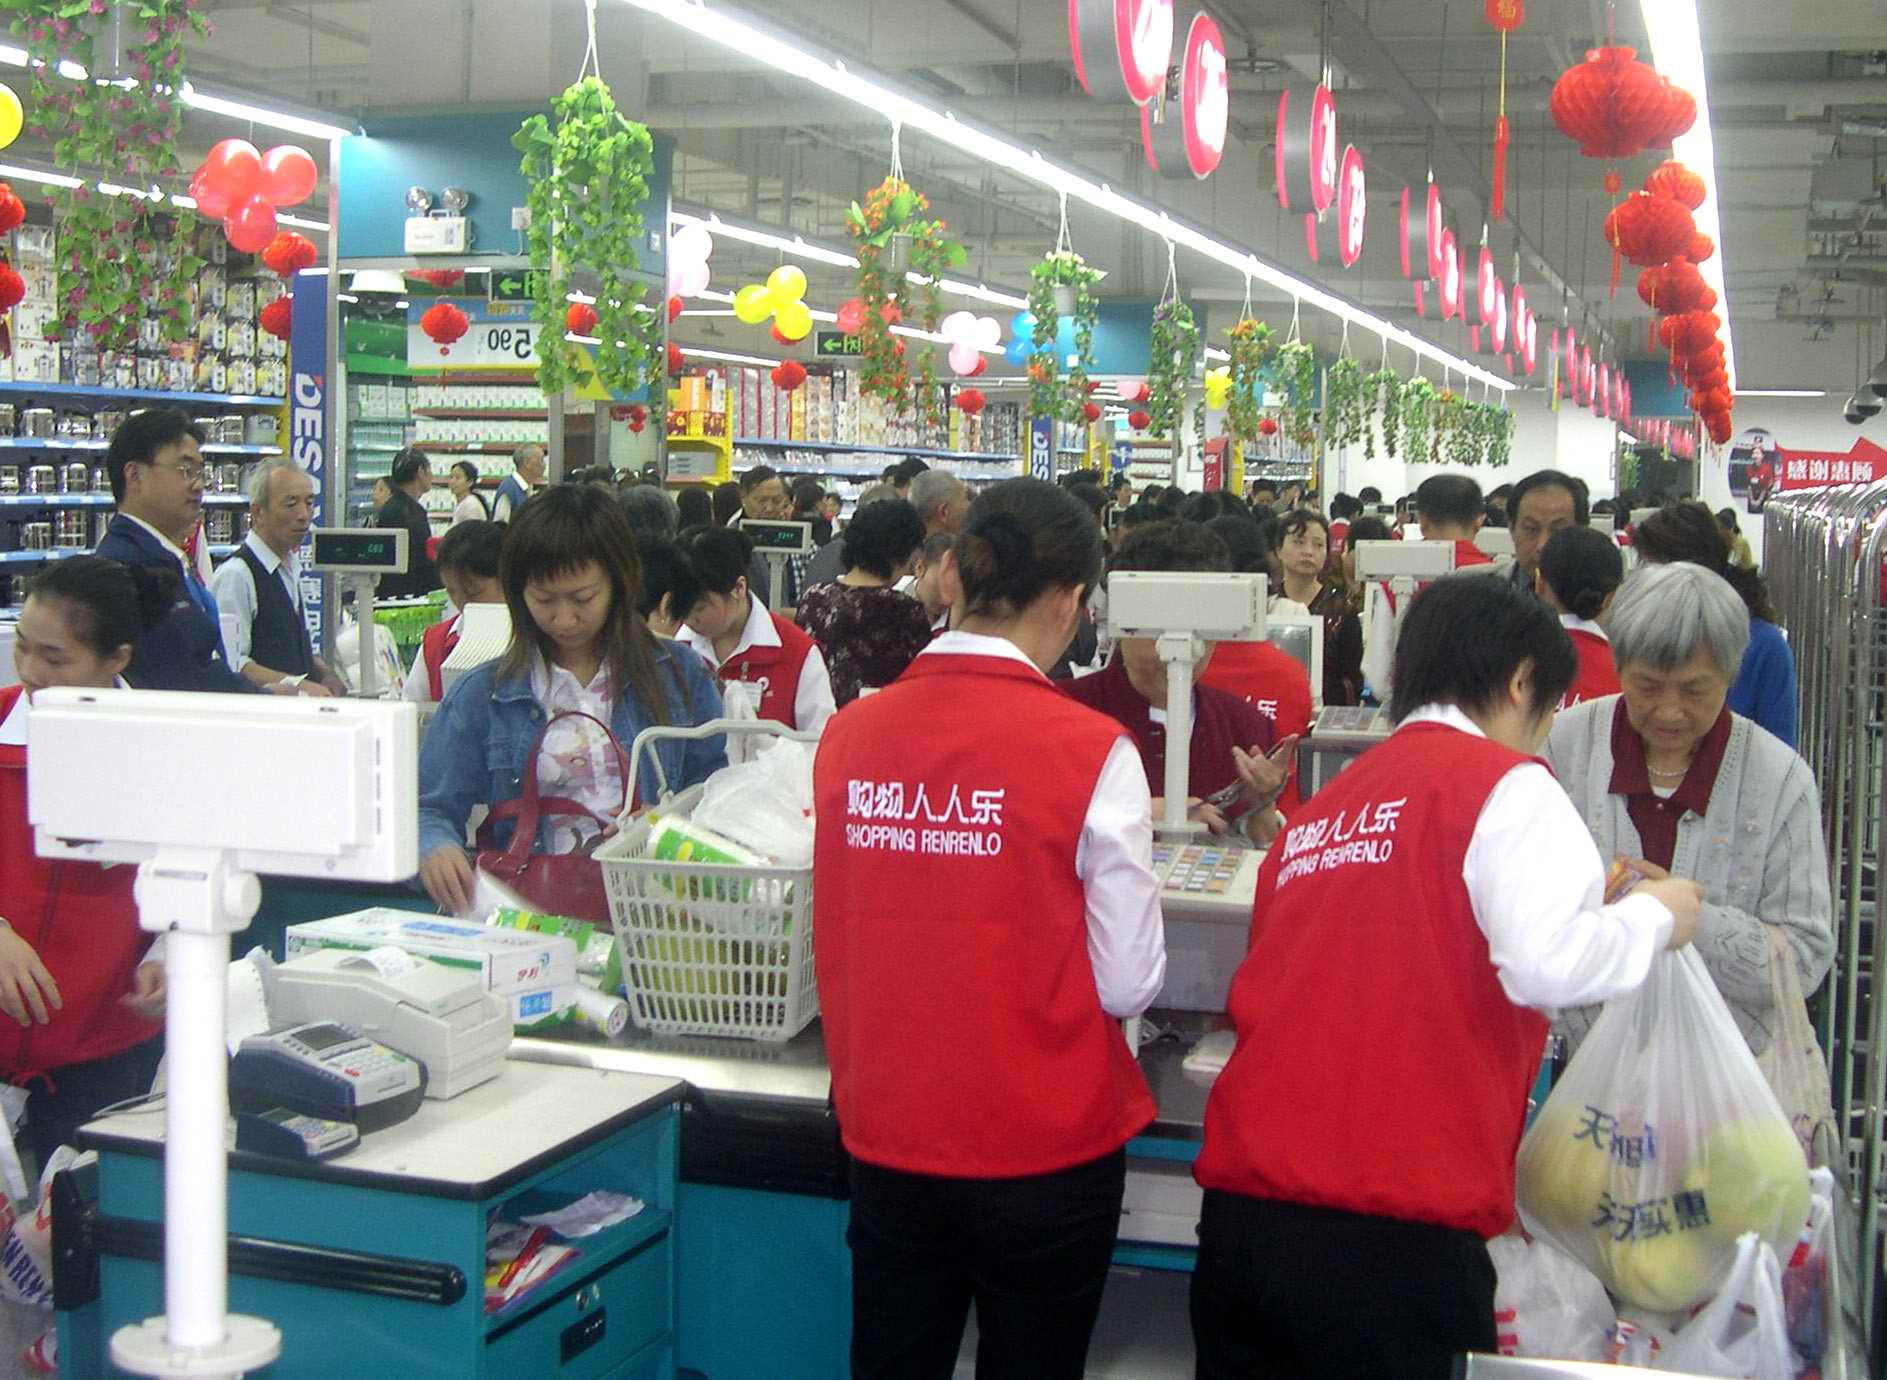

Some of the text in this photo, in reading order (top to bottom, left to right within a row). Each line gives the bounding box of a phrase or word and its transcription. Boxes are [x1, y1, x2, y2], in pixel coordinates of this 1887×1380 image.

[1787, 459, 1873, 482] 感谢惠顾
[847, 779, 1005, 826] 购物人人乐
[846, 823, 1002, 855] SHOPPING RENRENLO
[1280, 797, 1407, 862] 购物人人乐
[1319, 839, 1393, 871] RENRENLO
